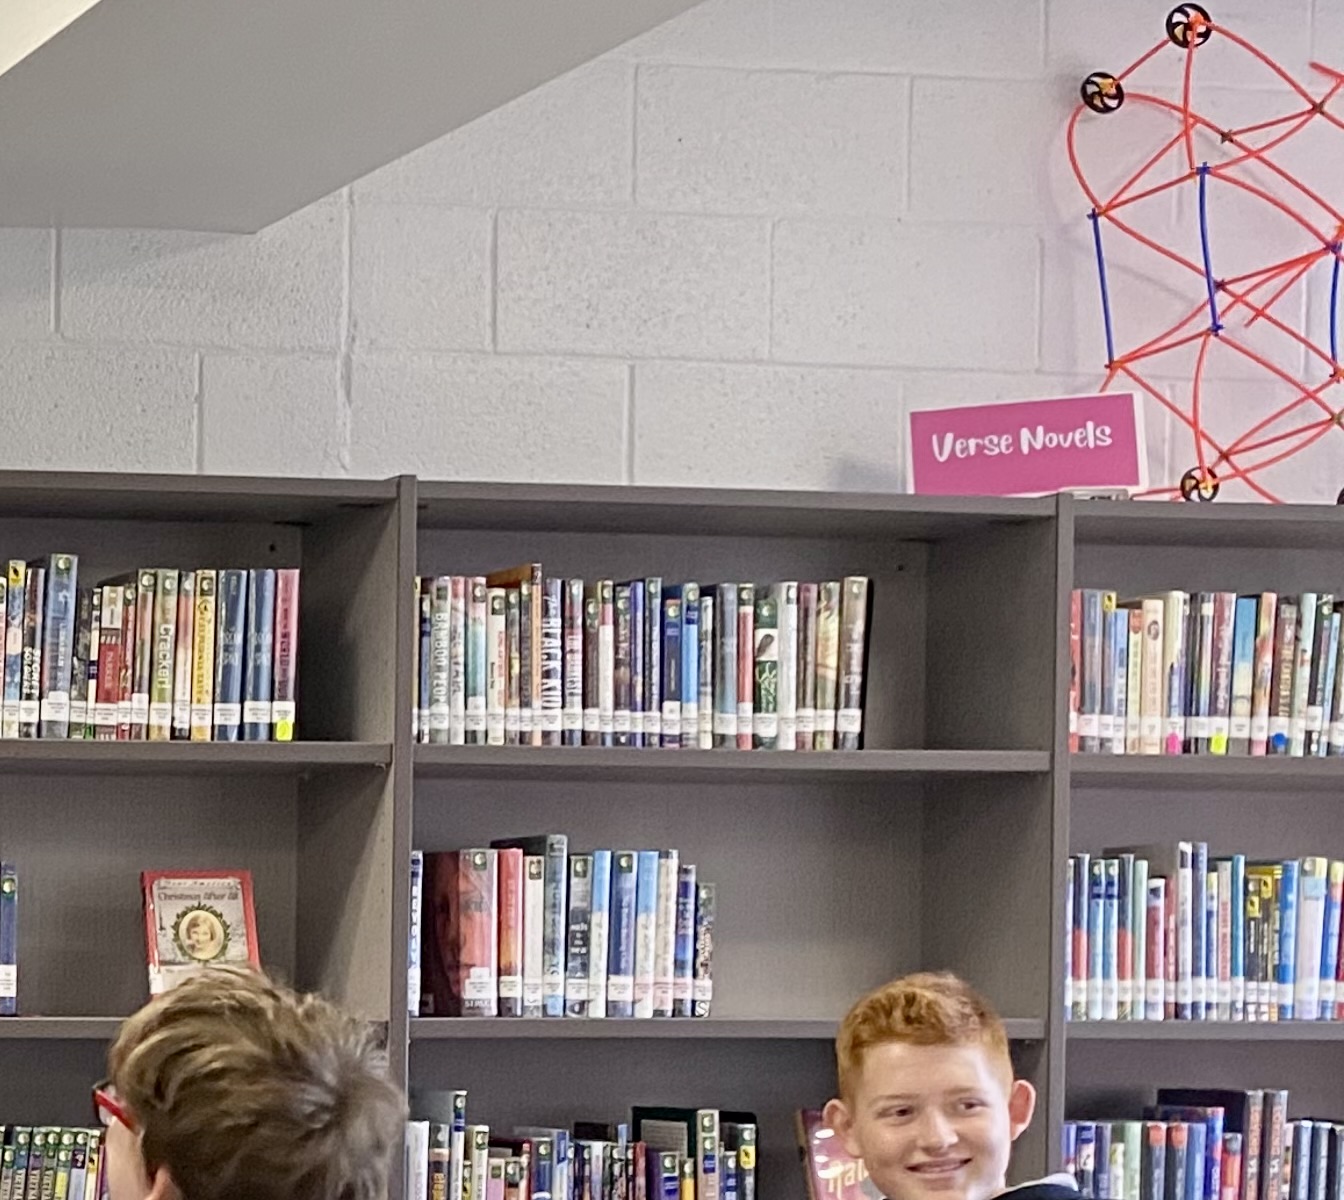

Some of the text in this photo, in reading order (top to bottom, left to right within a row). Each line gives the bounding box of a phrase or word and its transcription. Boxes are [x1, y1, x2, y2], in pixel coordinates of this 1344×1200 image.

[932, 421, 1113, 463] Verse Novels
[157, 624, 174, 689] Cracker!
[433, 613, 449, 705] BAMBOO PEOP
[542, 618, 562, 670] BLACK
[542, 678, 562, 709] KID
